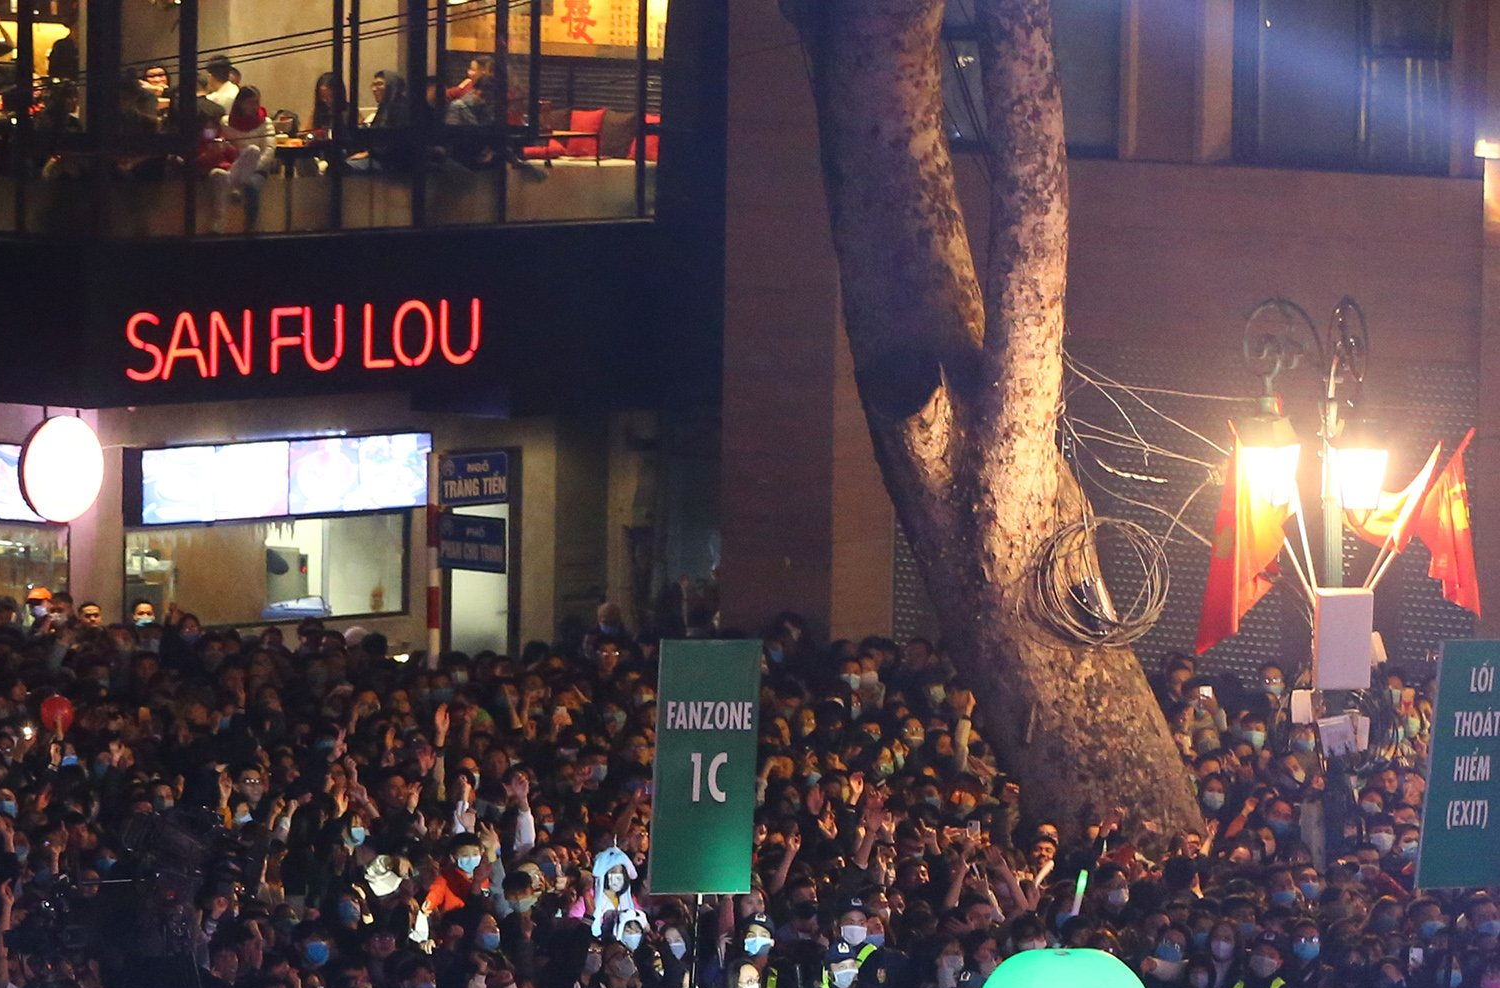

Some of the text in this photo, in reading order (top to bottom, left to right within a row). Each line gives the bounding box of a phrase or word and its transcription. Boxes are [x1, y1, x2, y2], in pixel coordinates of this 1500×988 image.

[125, 298, 481, 382] SAN FU LOU
[443, 476, 480, 498] TRÀNG
[1470, 660, 1495, 693] LỐI
[666, 701, 753, 730] FANZONE
[1453, 707, 1500, 738] THOÁT
[691, 752, 728, 802] 1C
[1453, 748, 1491, 782] HIỂM
[1446, 800, 1489, 830] (EXIT)
